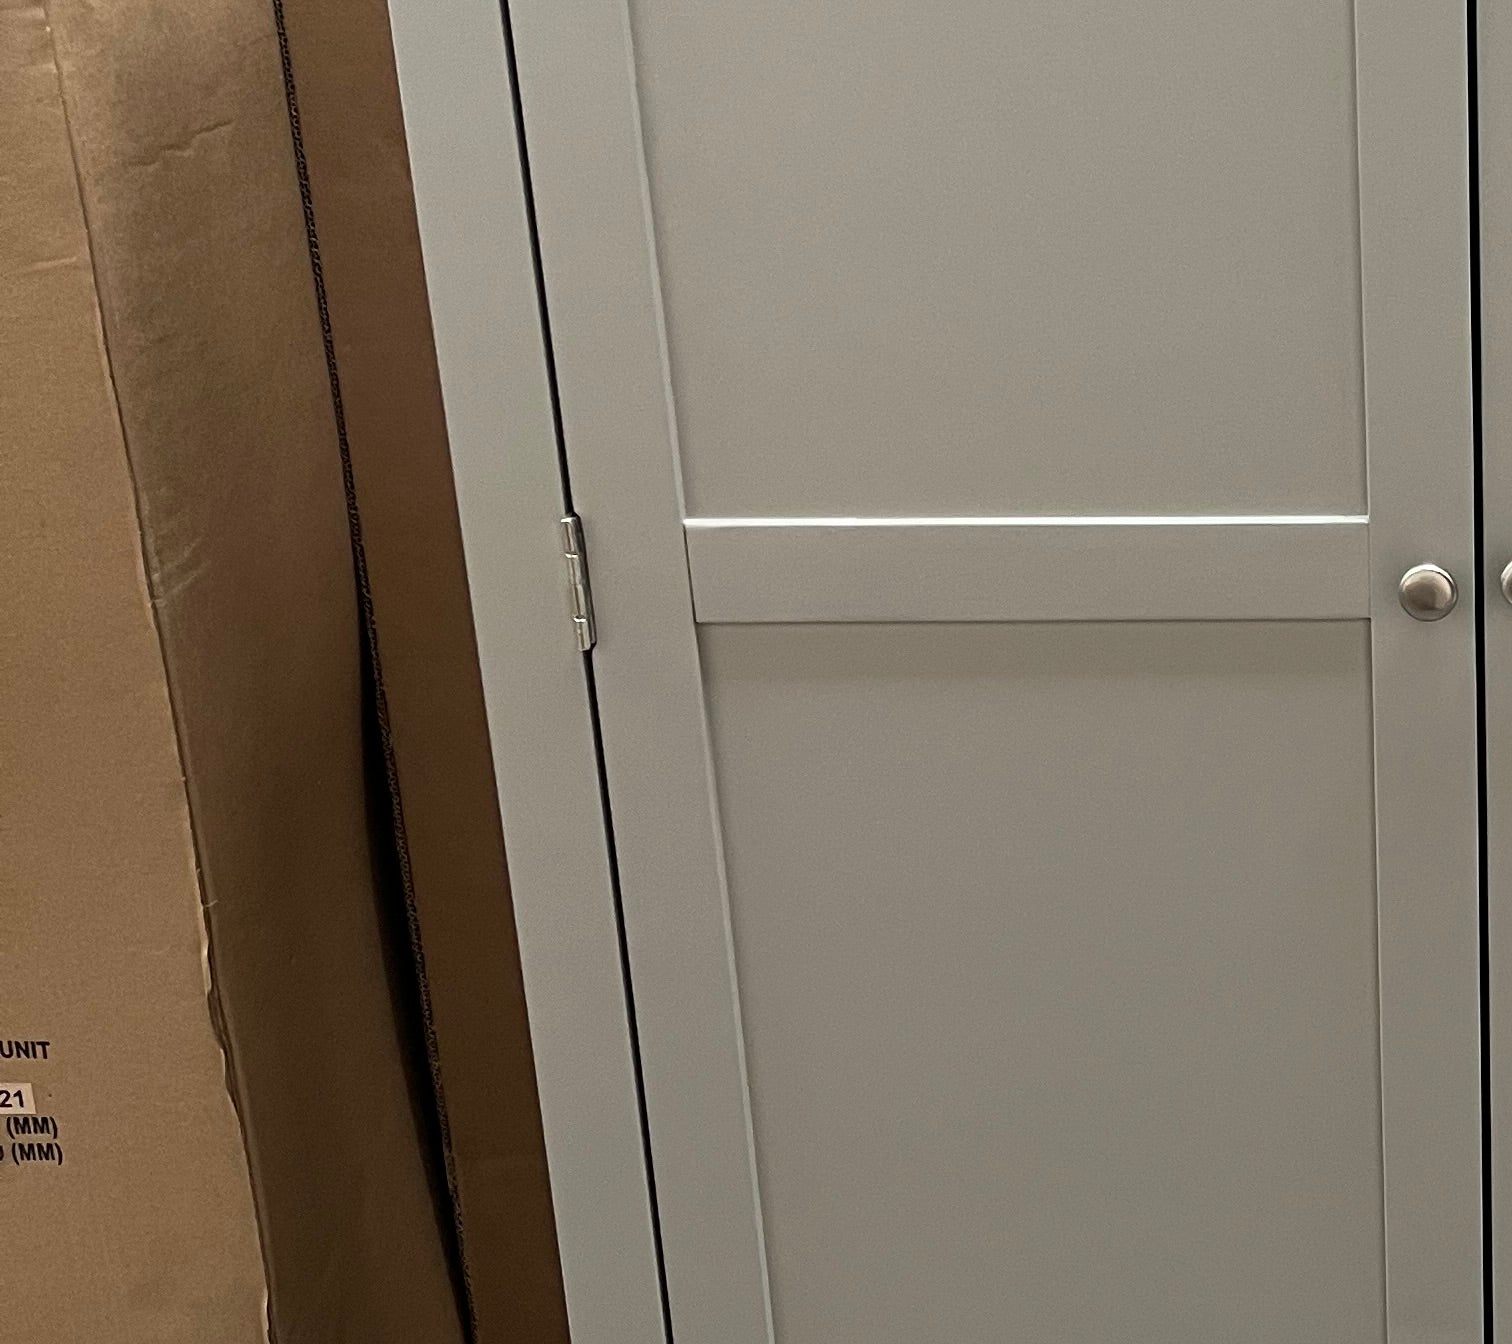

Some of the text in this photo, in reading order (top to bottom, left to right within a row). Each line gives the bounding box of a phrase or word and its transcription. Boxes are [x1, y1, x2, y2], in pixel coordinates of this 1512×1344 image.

[0, 1039, 51, 1060] UNIT
[6, 1116, 58, 1140] (MM)
[11, 1142, 63, 1166] (MM)
